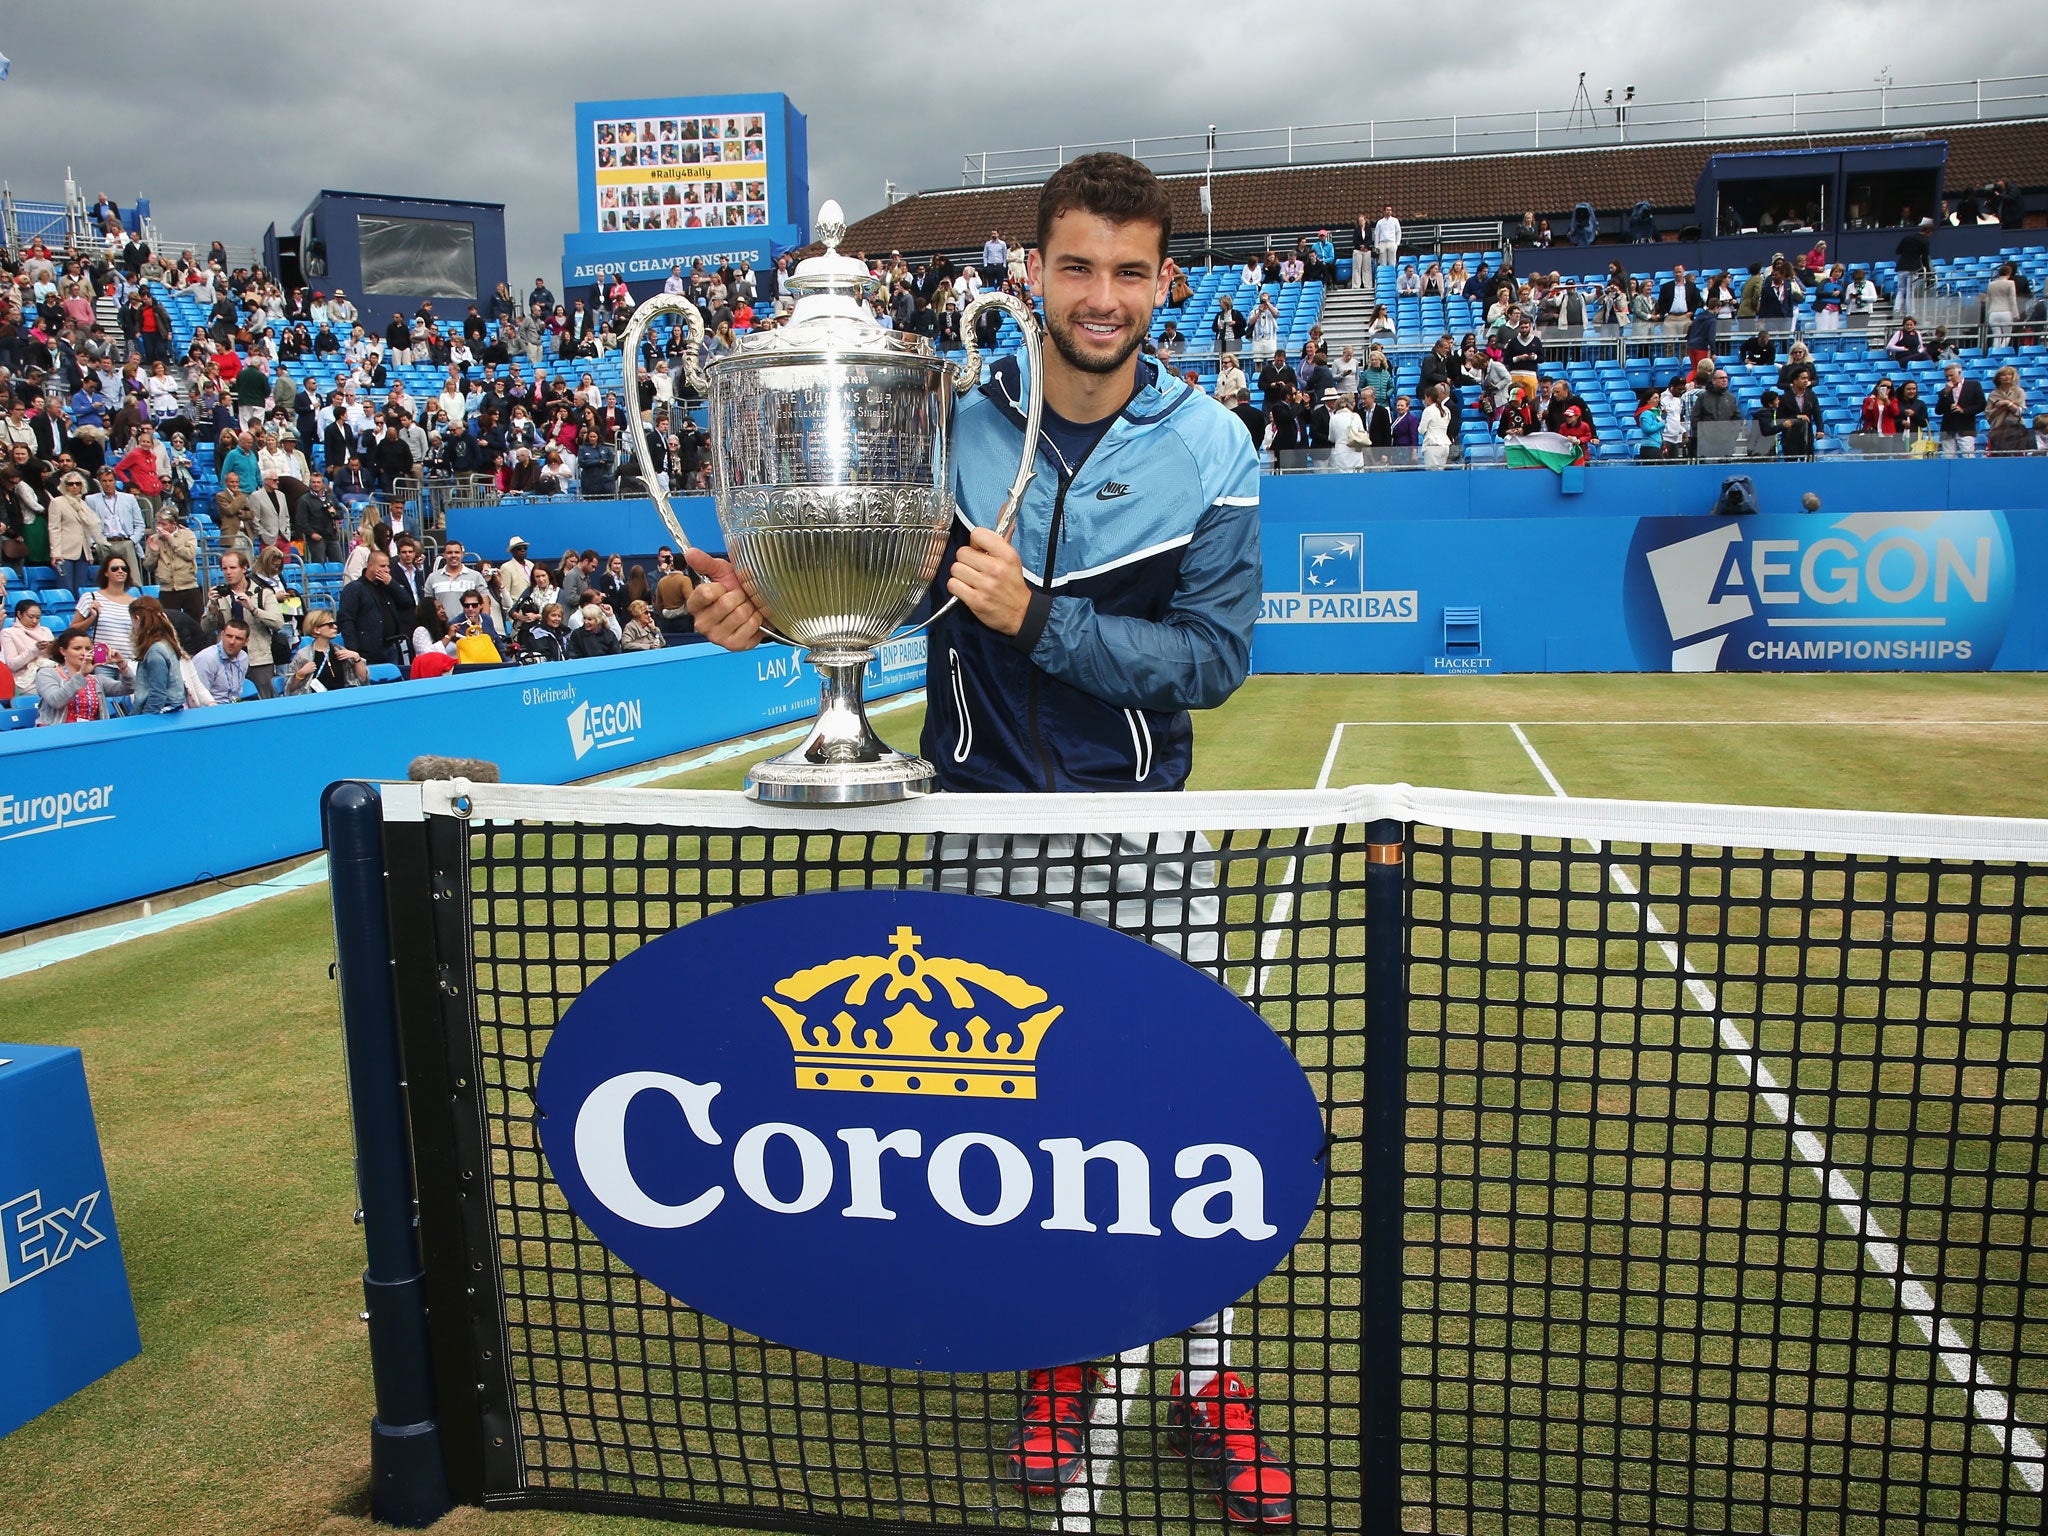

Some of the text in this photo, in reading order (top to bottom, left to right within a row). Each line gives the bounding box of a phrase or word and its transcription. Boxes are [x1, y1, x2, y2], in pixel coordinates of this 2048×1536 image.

[651, 167, 711, 180] #Rally4Bally
[574, 261, 626, 278] AEGON
[773, 389, 798, 404] THE
[803, 388, 861, 405] QUEN'S
[775, 407, 829, 419] GENTLEMEN
[1103, 481, 1130, 494] NIKE
[1707, 537, 1992, 605] AEGON
[1309, 596, 1413, 619] PARIBAS
[883, 639, 927, 667] BNP PARIBAS
[1747, 640, 1973, 661] CHAMPIONSHIPS
[757, 657, 788, 682] LAN
[1434, 657, 1492, 668] HACKETT
[533, 682, 576, 705] Retiready
[767, 697, 817, 716] LATAM AIRLINES
[584, 698, 642, 742] AEGON
[0, 784, 114, 828] Europcar
[573, 1070, 1278, 1242] Corona
[0, 1188, 107, 1294] Ex
